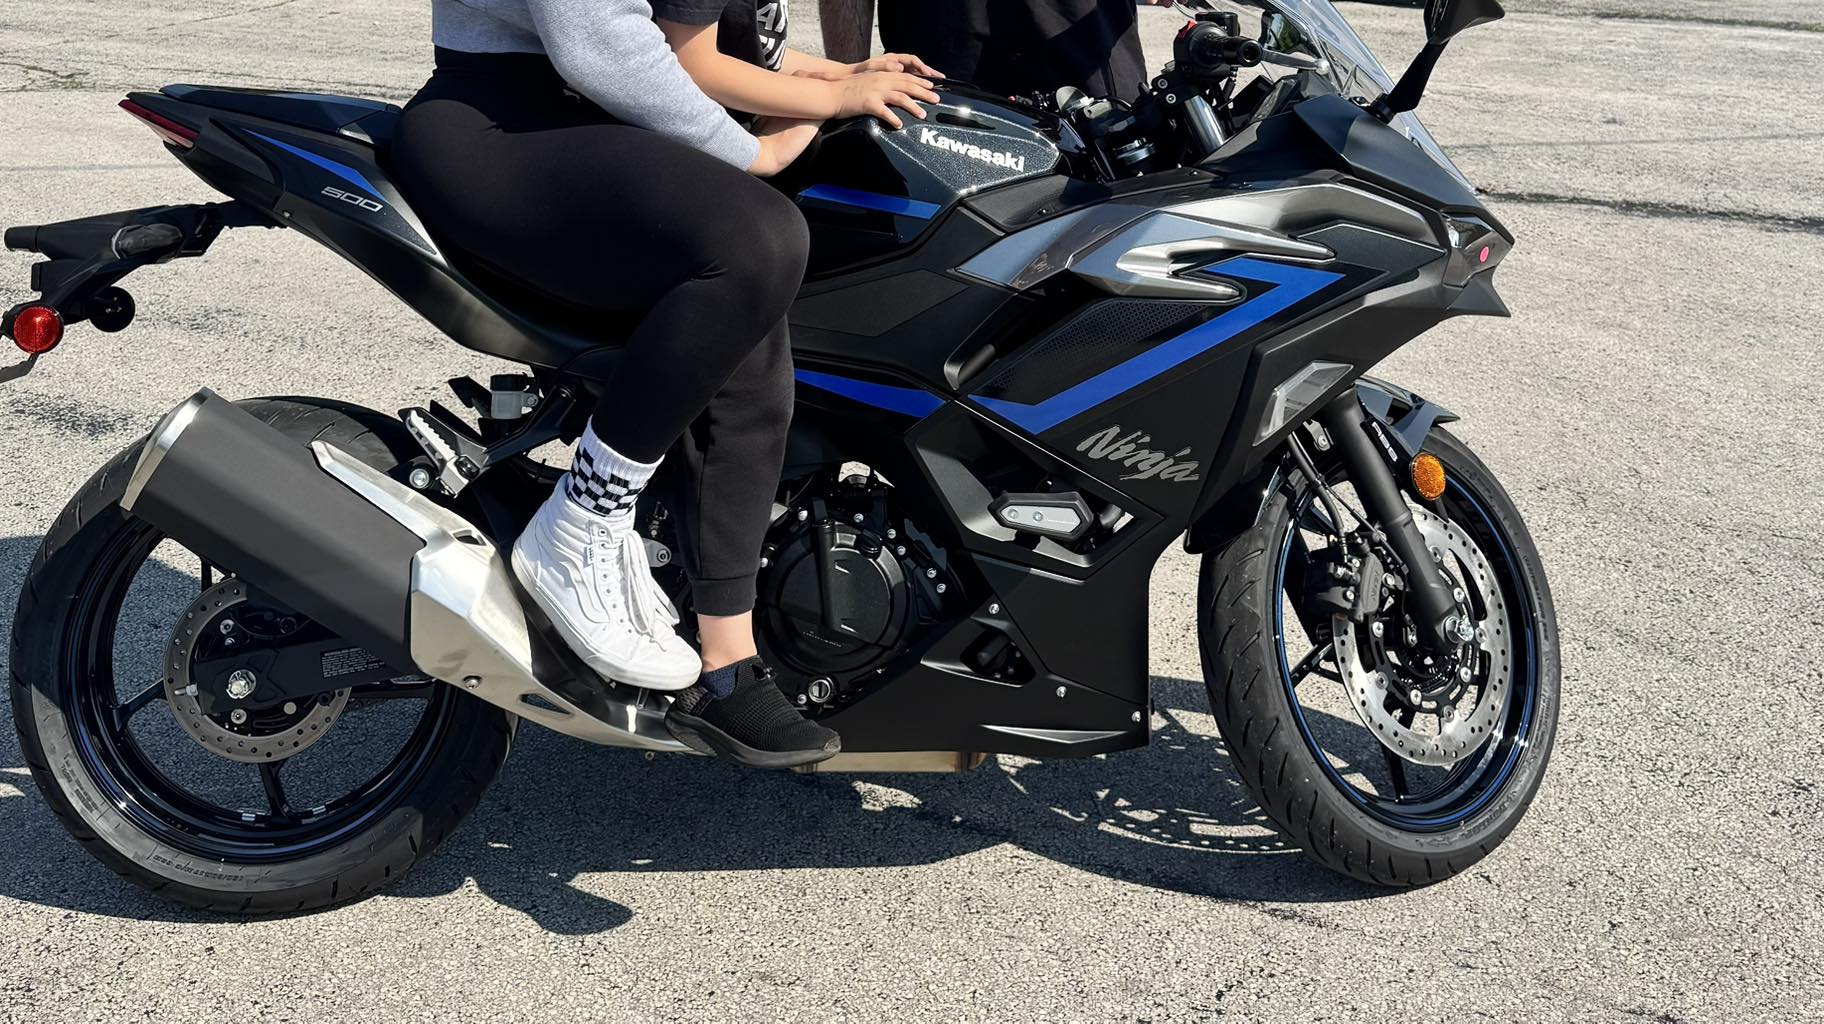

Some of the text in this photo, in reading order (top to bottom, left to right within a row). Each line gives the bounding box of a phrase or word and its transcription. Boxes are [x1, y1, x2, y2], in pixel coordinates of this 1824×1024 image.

[920, 127, 1025, 172] Kawasaki
[320, 186, 384, 213] 500
[1076, 425, 1200, 482] Ninja
[1371, 421, 1398, 462] ABS
